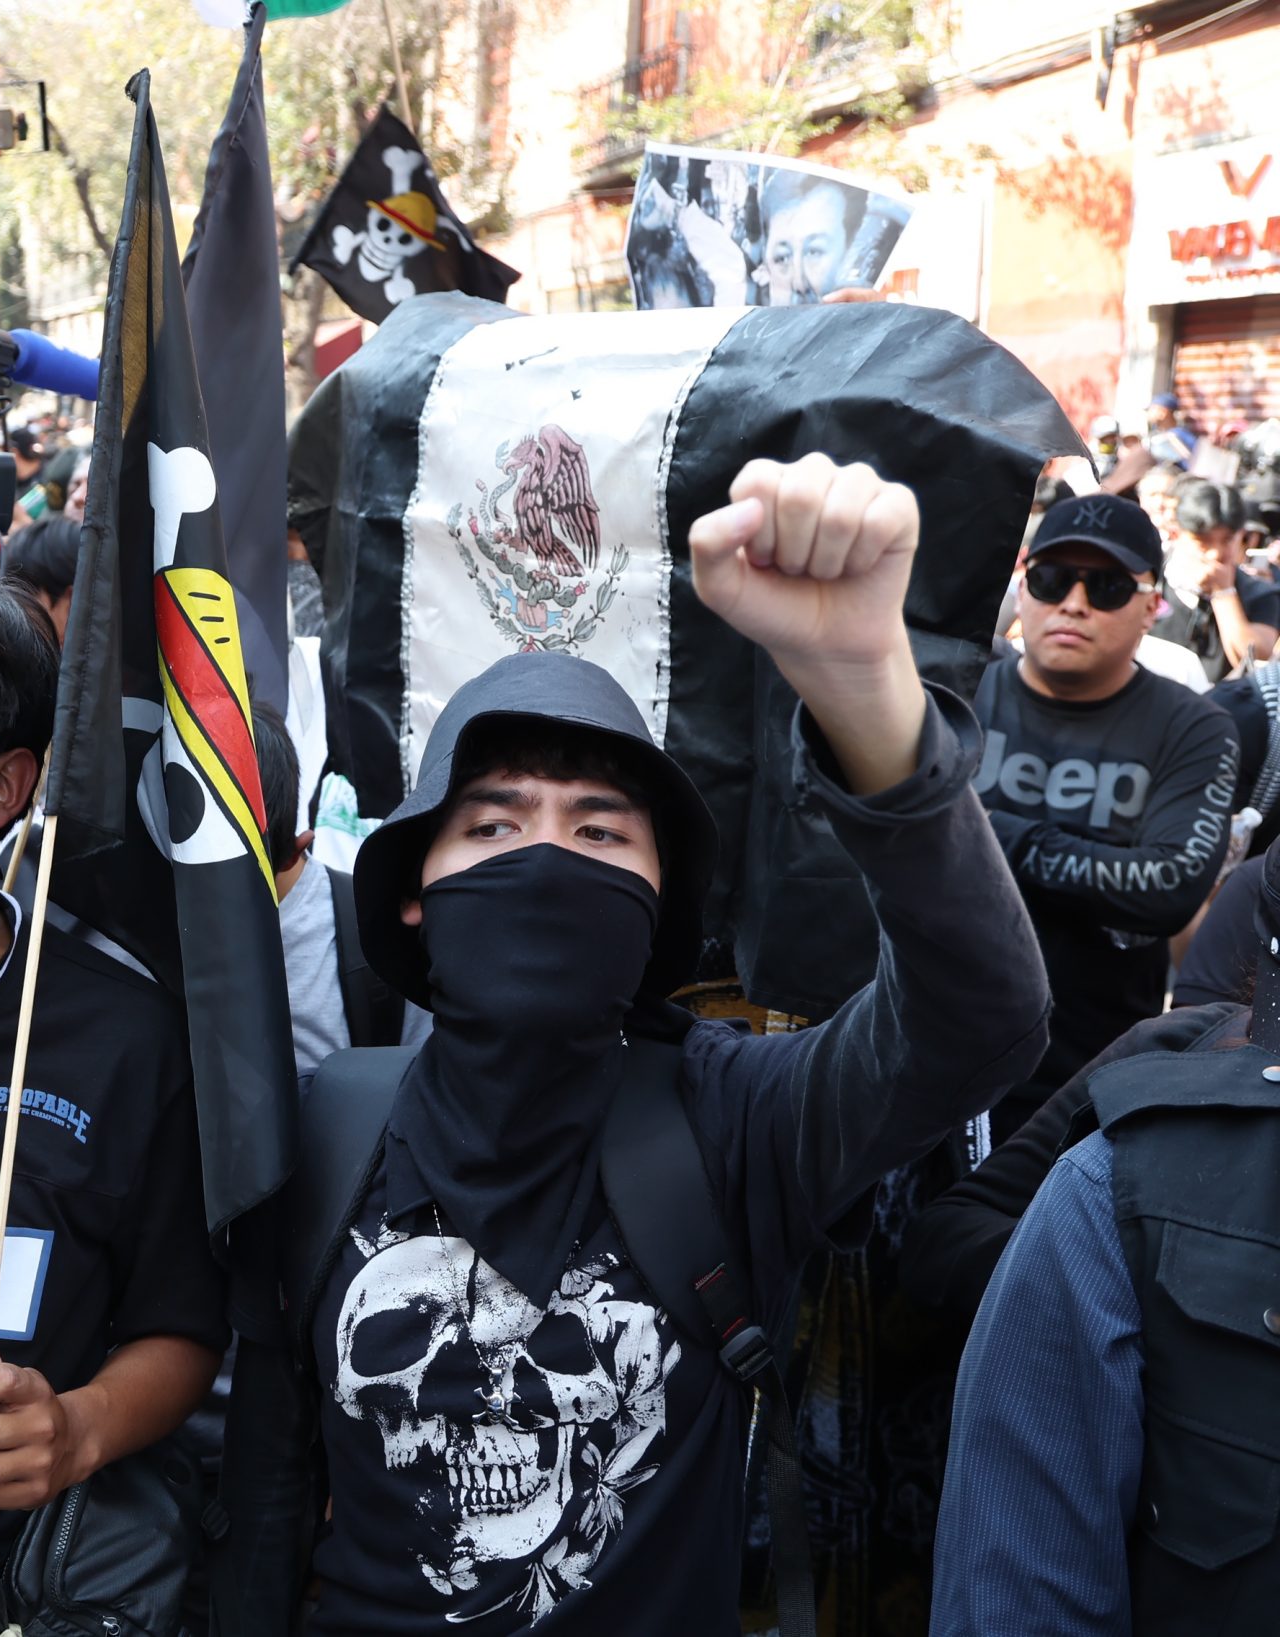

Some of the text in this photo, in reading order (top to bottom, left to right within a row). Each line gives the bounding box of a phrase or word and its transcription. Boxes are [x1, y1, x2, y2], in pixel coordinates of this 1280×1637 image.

[970, 729, 1152, 828] Jeep
[1021, 738, 1240, 891] FIND YOUR OWN WAY
[31, 1110, 65, 1127] CHAMPIONS
